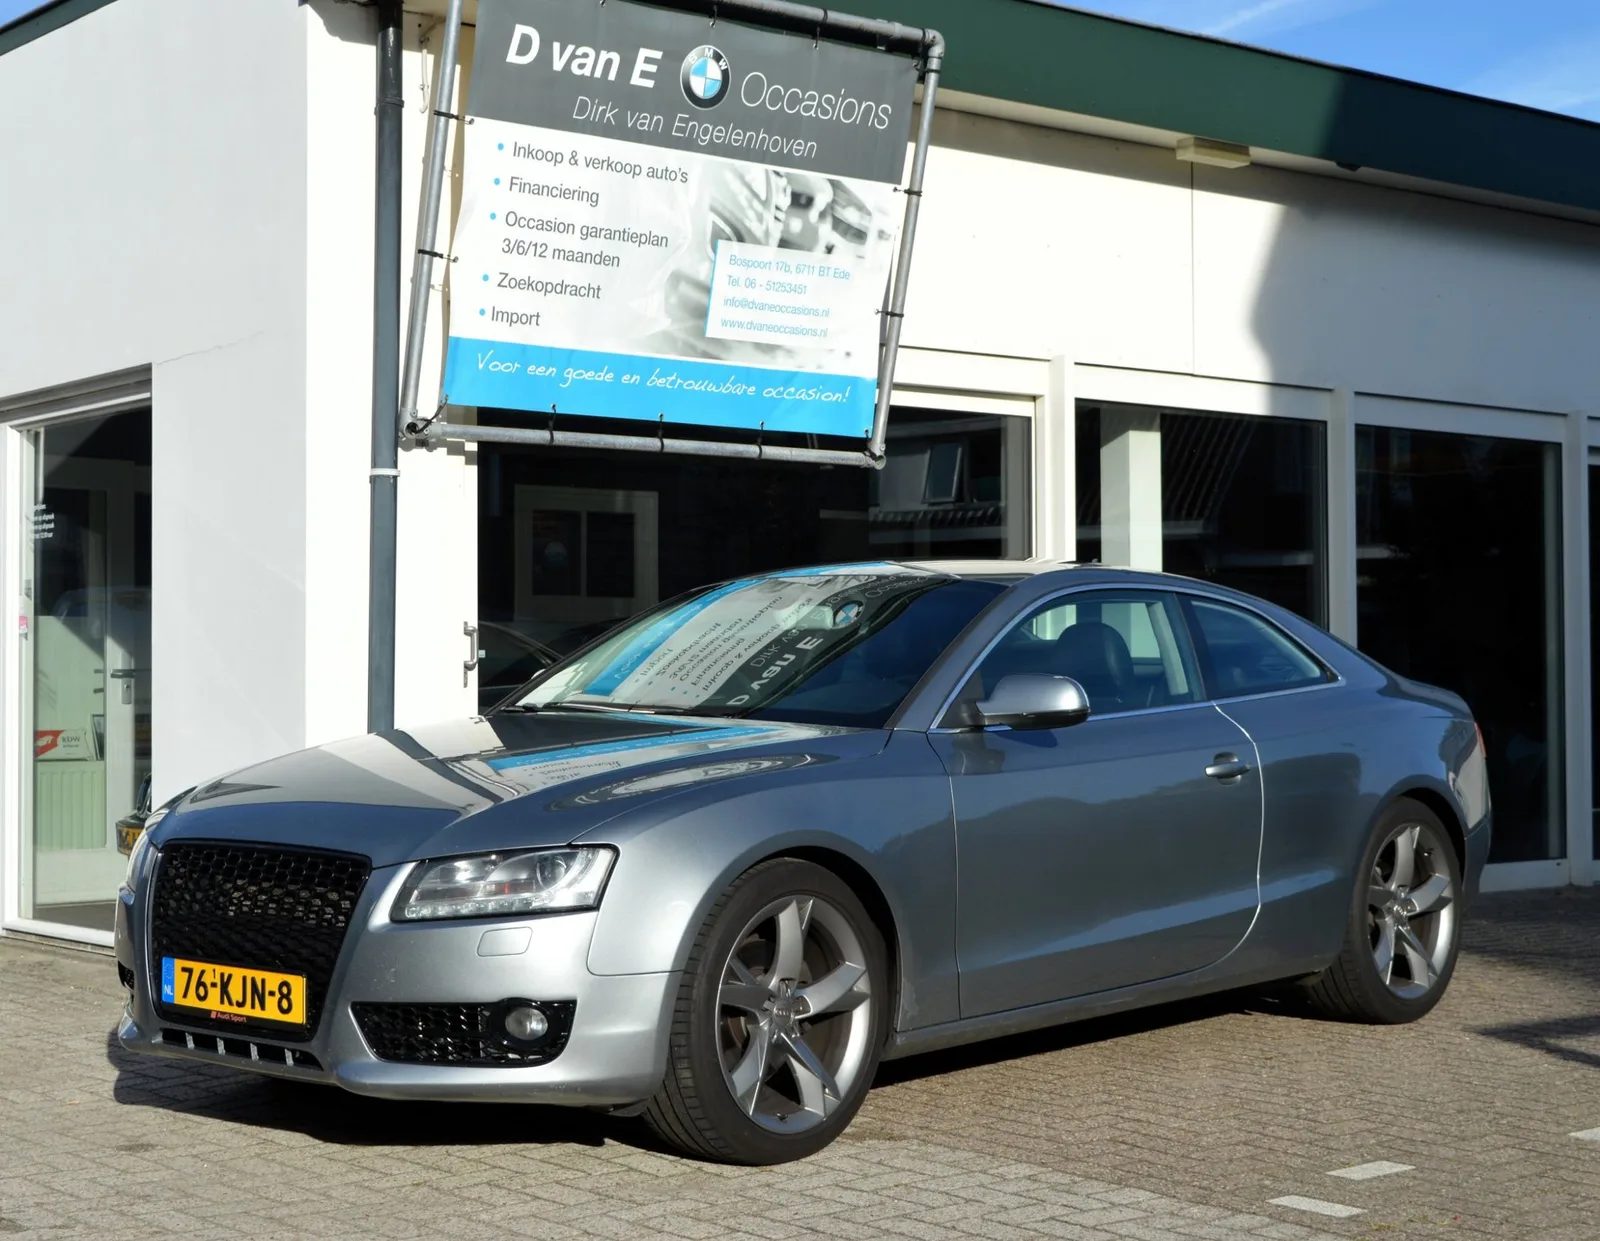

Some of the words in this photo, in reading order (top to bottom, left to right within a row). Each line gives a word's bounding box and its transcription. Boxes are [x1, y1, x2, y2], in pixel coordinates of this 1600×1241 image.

[506, 23, 541, 66] D
[551, 40, 620, 82] van
[630, 47, 663, 89] E
[740, 71, 893, 131] Occasions
[572, 95, 618, 126] Dirk
[627, 109, 664, 135] van
[672, 114, 818, 160] Engelenhoven
[513, 141, 564, 169] Inkoop
[568, 150, 580, 167] &
[584, 155, 643, 180] verkoop
[647, 165, 689, 184] auto's
[509, 176, 600, 207] Financiering
[505, 211, 576, 237] Occasion
[580, 221, 669, 251] garantieplan
[501, 238, 548, 260] 3/6/12
[552, 244, 621, 268] maanden
[729, 254, 772, 271] Bospoort
[776, 261, 793, 274] 17b,
[795, 263, 815, 276] 6711
[818, 265, 831, 277] BT
[833, 268, 850, 280] Ede
[497, 272, 602, 300] Zoekopdracht
[727, 275, 742, 288] Tel.
[744, 277, 757, 290] 06
[765, 280, 807, 295] 51253451
[491, 305, 541, 329] Import
[723, 296, 830, 318] info@dvaneoccasions.nl
[721, 318, 828, 338] www.dvaneoccasions.nl
[477, 349, 521, 374] Voor
[526, 364, 558, 378] een
[559, 365, 615, 388] goede
[621, 373, 641, 385] en
[646, 368, 756, 396] betrouwbare
[762, 385, 851, 403] occasion!
[164, 984, 174, 996] NL
[180, 966, 293, 1015] 76-KJN-8
[217, 1011, 230, 1020] Audi
[230, 1014, 247, 1023] Sport
